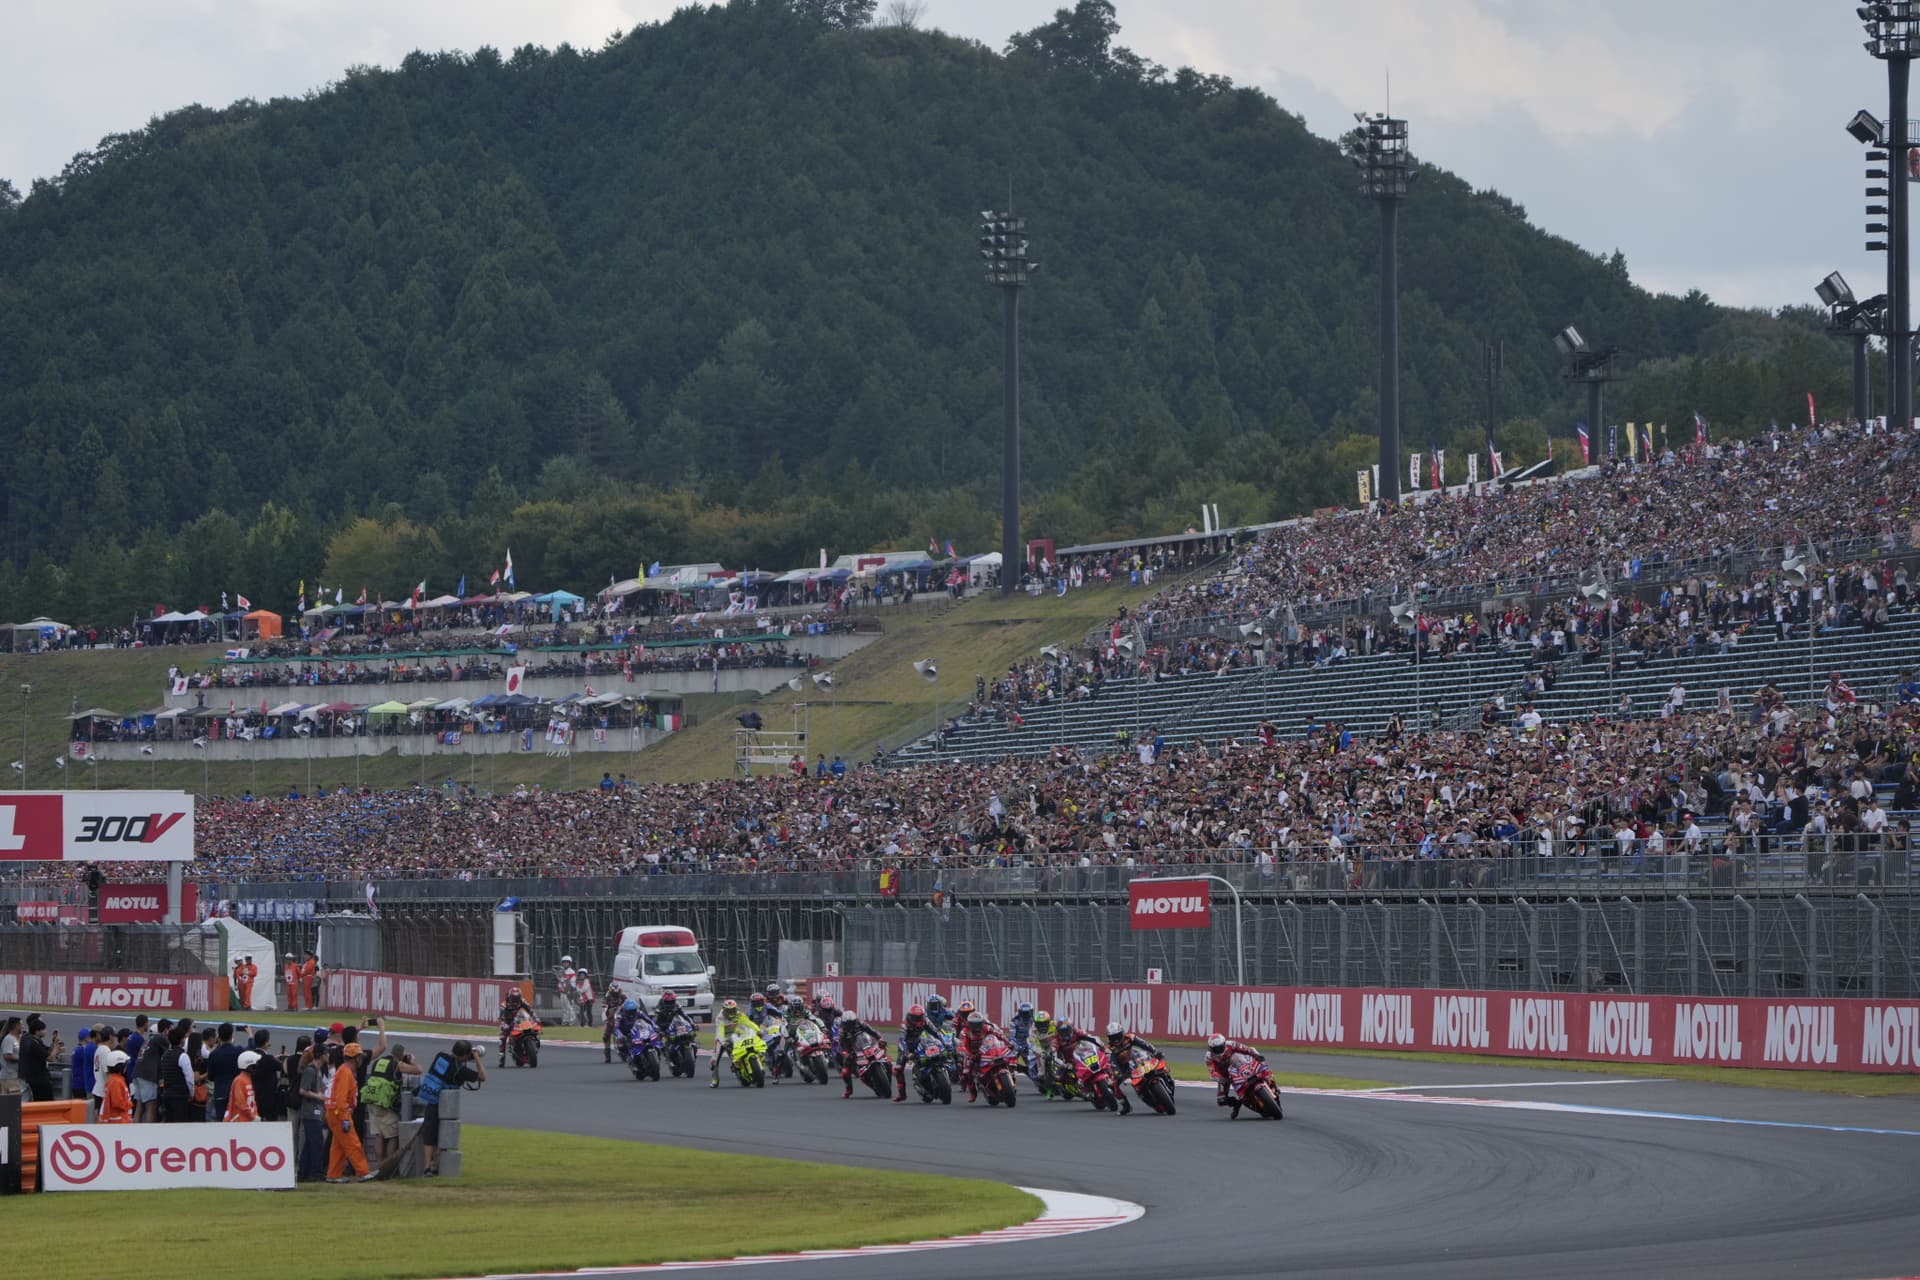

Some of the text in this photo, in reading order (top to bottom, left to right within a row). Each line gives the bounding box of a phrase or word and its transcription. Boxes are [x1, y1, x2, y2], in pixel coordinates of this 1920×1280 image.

[74, 813, 186, 843] 300V
[105, 896, 160, 910] MOTUL
[1135, 896, 1205, 915] MOTUL
[88, 987, 173, 1007] MOTUL
[856, 981, 892, 1022] MOTUL
[1108, 988, 1154, 1034] MOTUL
[1167, 990, 1214, 1037] MOTUL
[1228, 991, 1277, 1040] MOTUL
[1292, 993, 1344, 1043] MOTUL
[1359, 994, 1415, 1045] MOTUL
[1431, 996, 1490, 1049] MOTUL
[1507, 998, 1569, 1052] MOTUL
[1587, 1001, 1653, 1056] MOTUL
[1673, 1003, 1742, 1060] MOTUL
[1763, 1006, 1838, 1064] MOTUL
[115, 1139, 286, 1173] brembo
